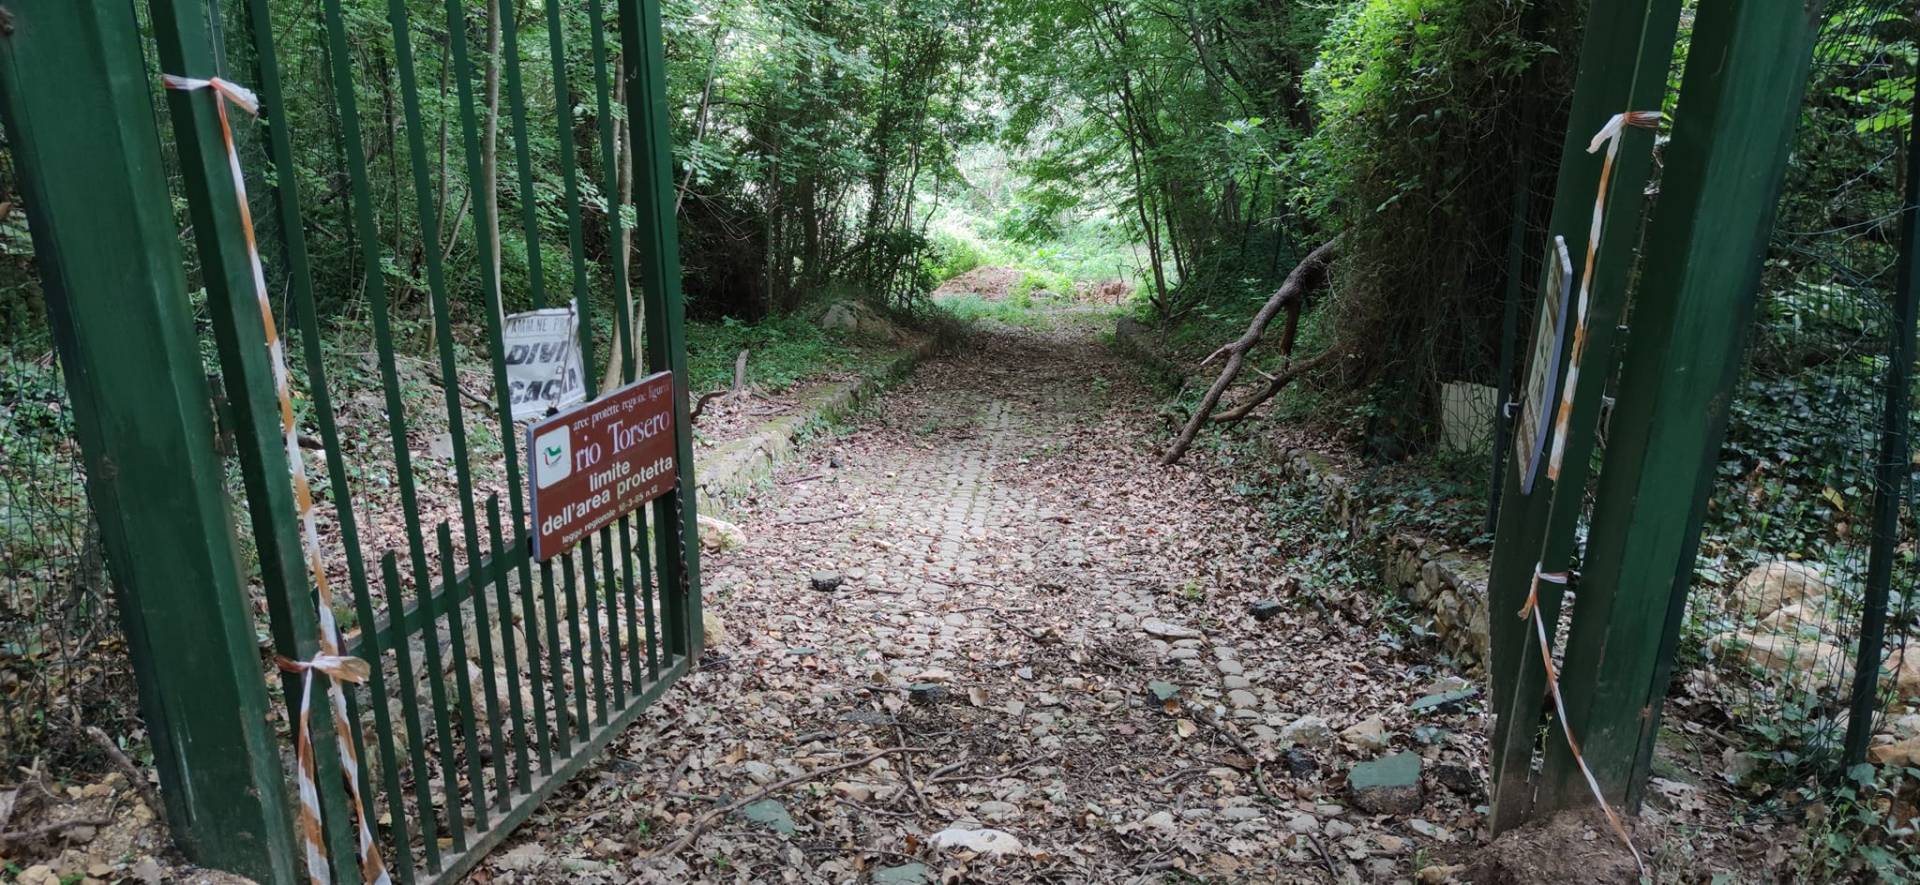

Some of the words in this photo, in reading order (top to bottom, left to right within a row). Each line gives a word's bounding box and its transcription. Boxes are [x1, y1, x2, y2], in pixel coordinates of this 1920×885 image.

[573, 418, 589, 431] aree
[591, 406, 620, 429] protette
[575, 435, 601, 473] rio
[607, 411, 670, 455] Torsero
[589, 461, 630, 492] limite
[542, 489, 610, 536] dell'area
[616, 457, 673, 500] protetta
[562, 529, 583, 545] legge
[584, 509, 616, 531] regionale
